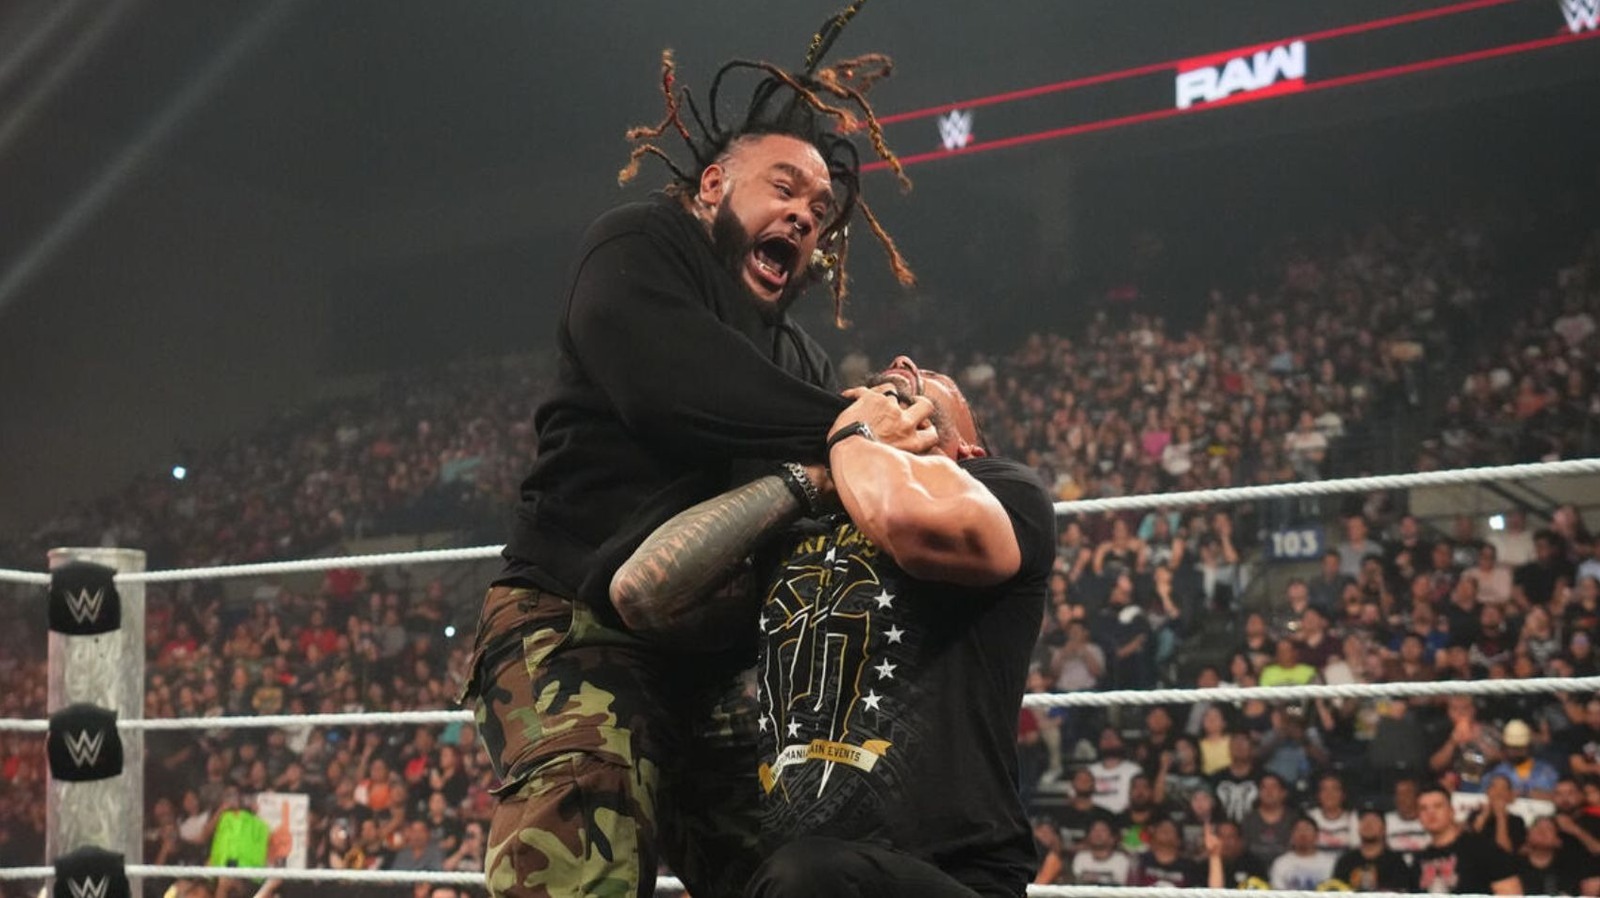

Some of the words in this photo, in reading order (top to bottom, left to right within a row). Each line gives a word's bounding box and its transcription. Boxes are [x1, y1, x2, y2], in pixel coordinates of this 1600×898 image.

[1176, 39, 1307, 109] RAW
[1272, 530, 1318, 557] 103
[827, 746, 861, 762] EVENTS
